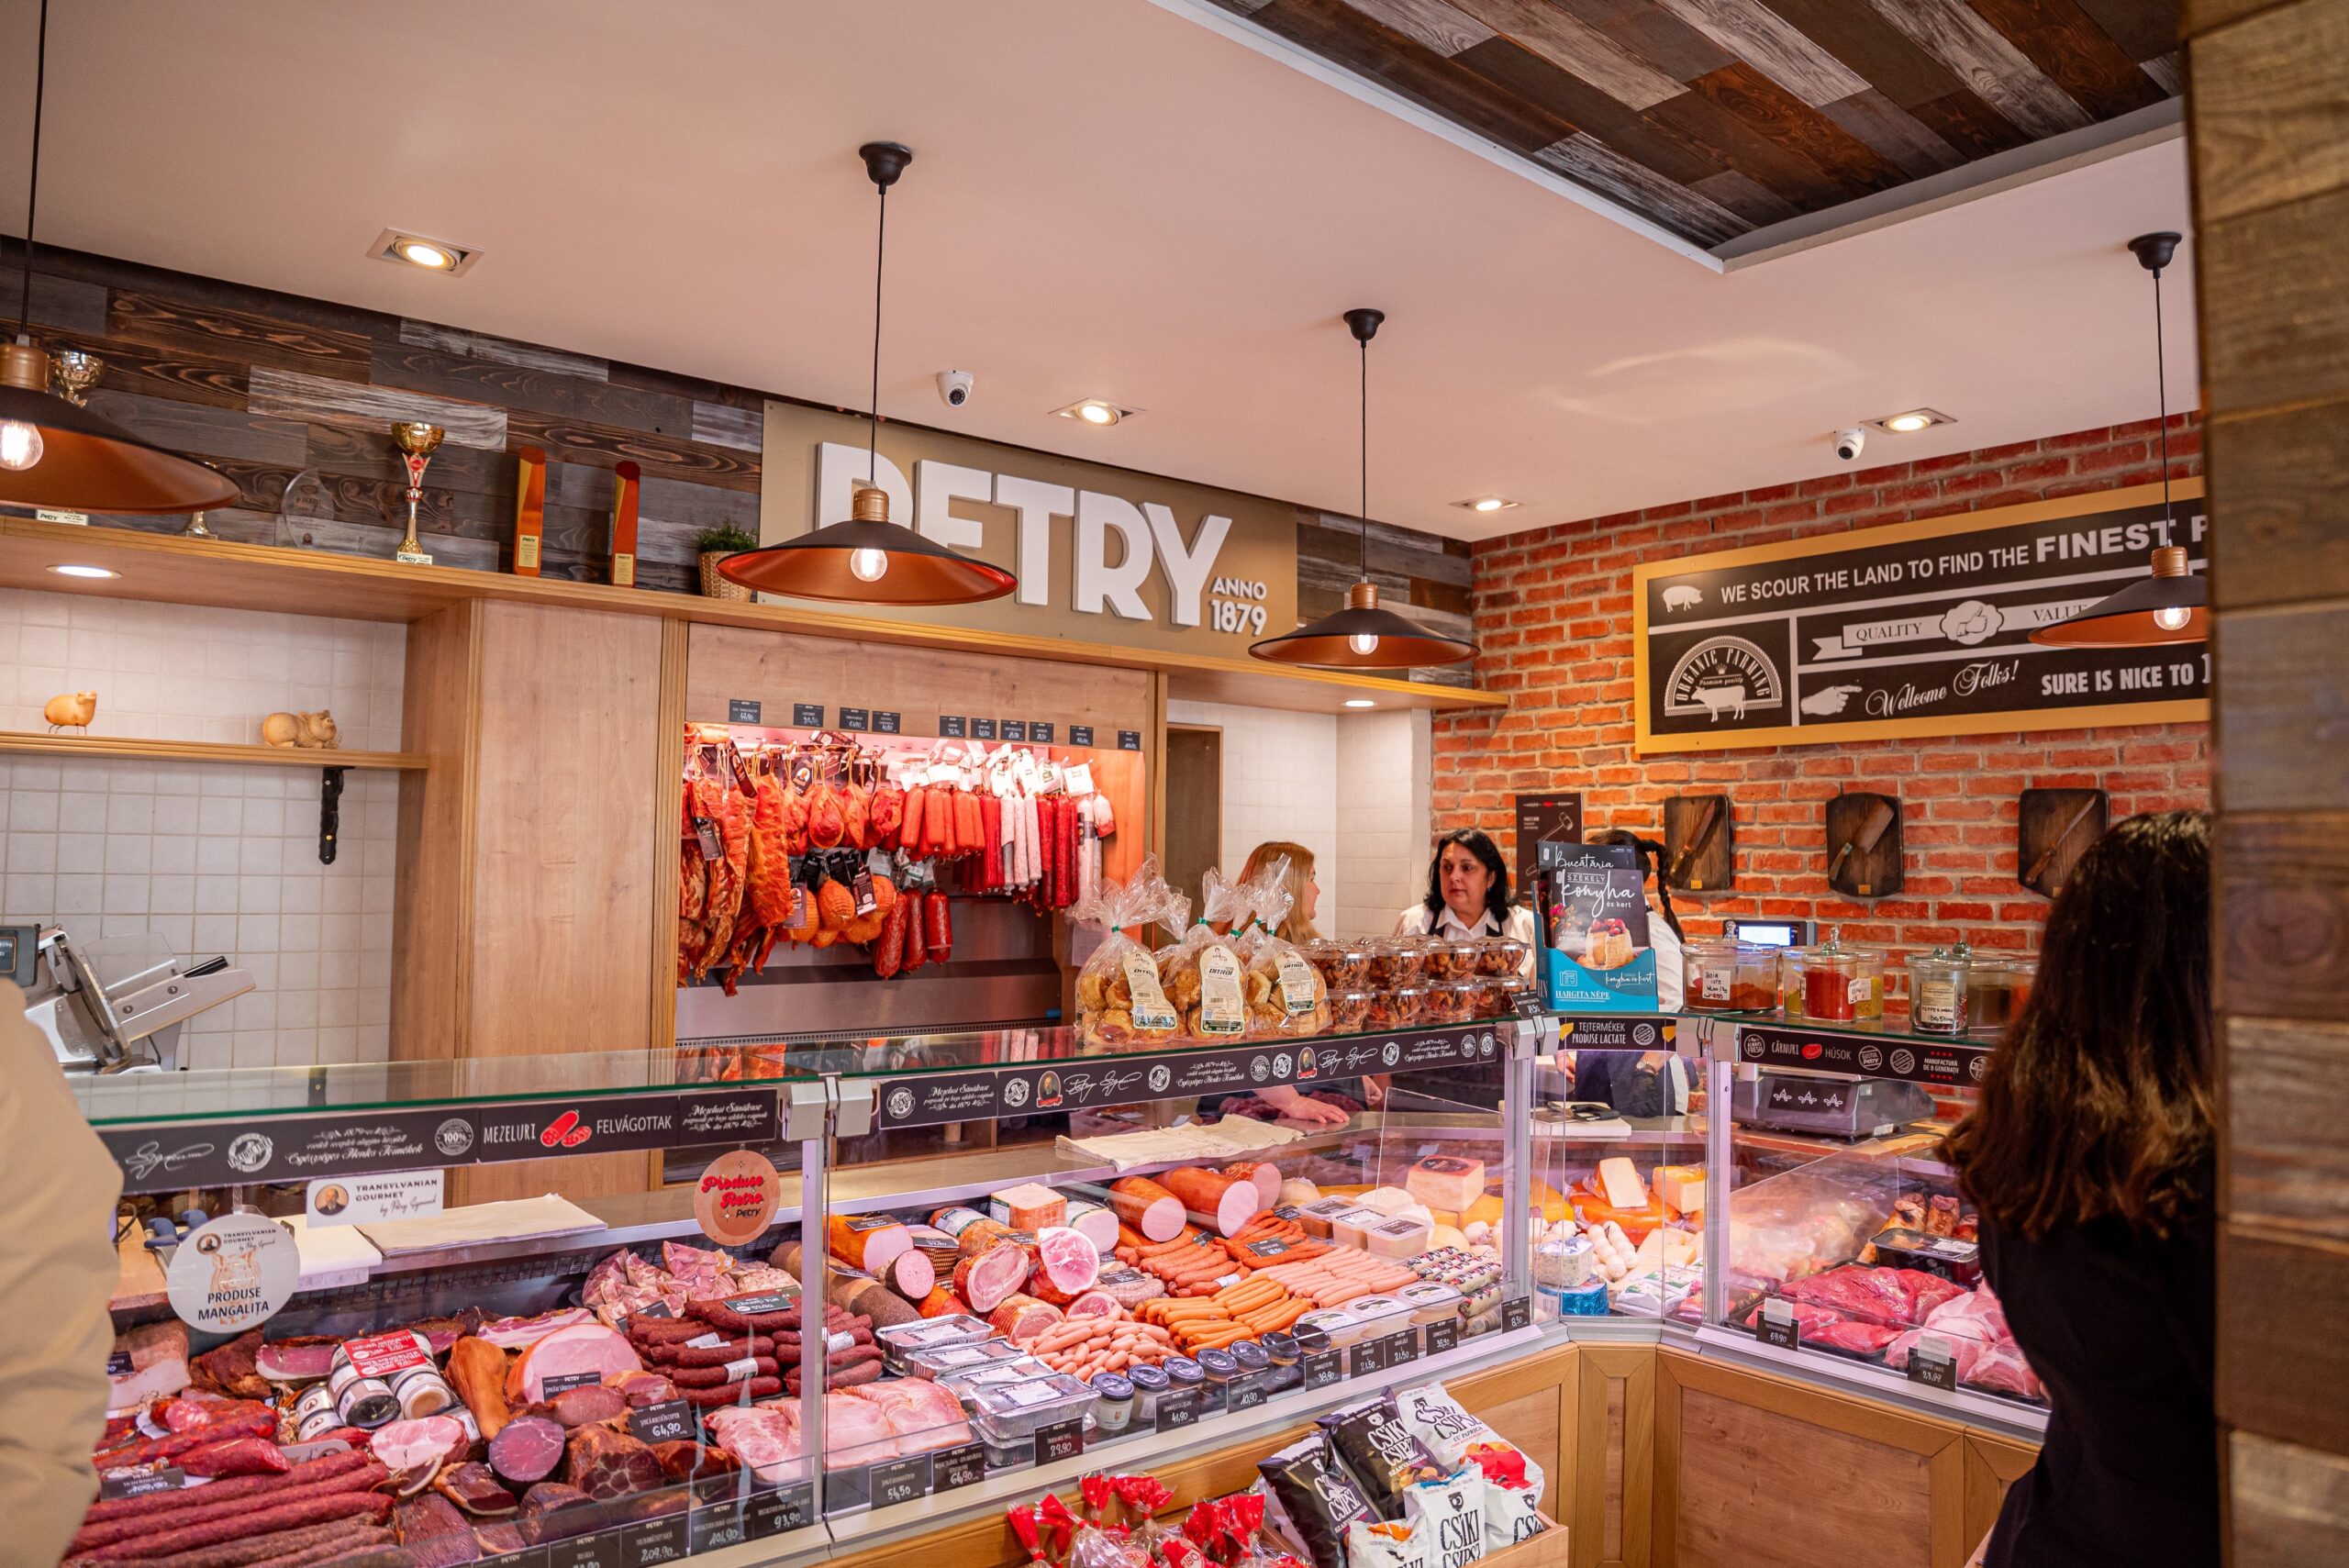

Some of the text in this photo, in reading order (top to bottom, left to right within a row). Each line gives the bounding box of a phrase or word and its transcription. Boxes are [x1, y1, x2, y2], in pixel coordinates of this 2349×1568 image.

[1720, 585, 1746, 604] WE
[1751, 576, 1809, 600] SCOUR
[1814, 570, 1848, 592] THE
[1854, 562, 1902, 586] LAND
[1908, 559, 1933, 579] TO
[1939, 550, 1983, 575] FIND
[1988, 545, 2029, 568] THE
[2036, 518, 2176, 562] FINEST
[1209, 576, 1267, 600] ANNO
[1208, 599, 1267, 637] 1879
[1855, 622, 1922, 642] QUALITY
[1675, 649, 1718, 701] ORGANIC
[1725, 647, 1771, 697] FARMING
[2042, 672, 2088, 696] SURE
[2096, 669, 2112, 692] IS
[2120, 666, 2163, 691] NICE
[2169, 662, 2194, 685] TO
[1865, 683, 1947, 717] Wellcome
[1567, 873, 1606, 883] SZÉKELY
[1591, 990, 1610, 998] NÉPE
[1578, 1021, 1625, 1032] TEJTERMÉKEK
[1572, 1033, 1626, 1044] PRODUSE LACTATE
[1825, 1047, 1852, 1061] HÚSOK
[596, 1115, 672, 1135] FELVÁGOTTAK
[443, 1131, 467, 1143] 100%
[484, 1123, 536, 1144] MEZELURI
[356, 1179, 438, 1193] TRANSYLVANIAN
[701, 1174, 764, 1194] Produse
[356, 1191, 404, 1201] GOURMET
[719, 1191, 764, 1209] Retro
[224, 1229, 276, 1239] TRANSYLVANIAN
[224, 1236, 254, 1244] GOURMET
[207, 1286, 262, 1304] PRODUSE
[198, 1300, 269, 1320] MANGALIȚA
[650, 1404, 665, 1412] PETRY
[1171, 1410, 1188, 1424] 41,90
[652, 1422, 681, 1437] 64,90
[1050, 1441, 1073, 1457] 29,90
[951, 1471, 974, 1485] 64,90
[776, 1488, 793, 1497] PETRY
[887, 1485, 911, 1501] 54,50
[713, 1504, 731, 1513] PETRY
[646, 1521, 663, 1530] PETRY
[774, 1513, 801, 1529] 93,90
[1441, 1509, 1480, 1551] CSÍKI
[576, 1536, 596, 1545] PETRY
[501, 1554, 521, 1564] PETRY
